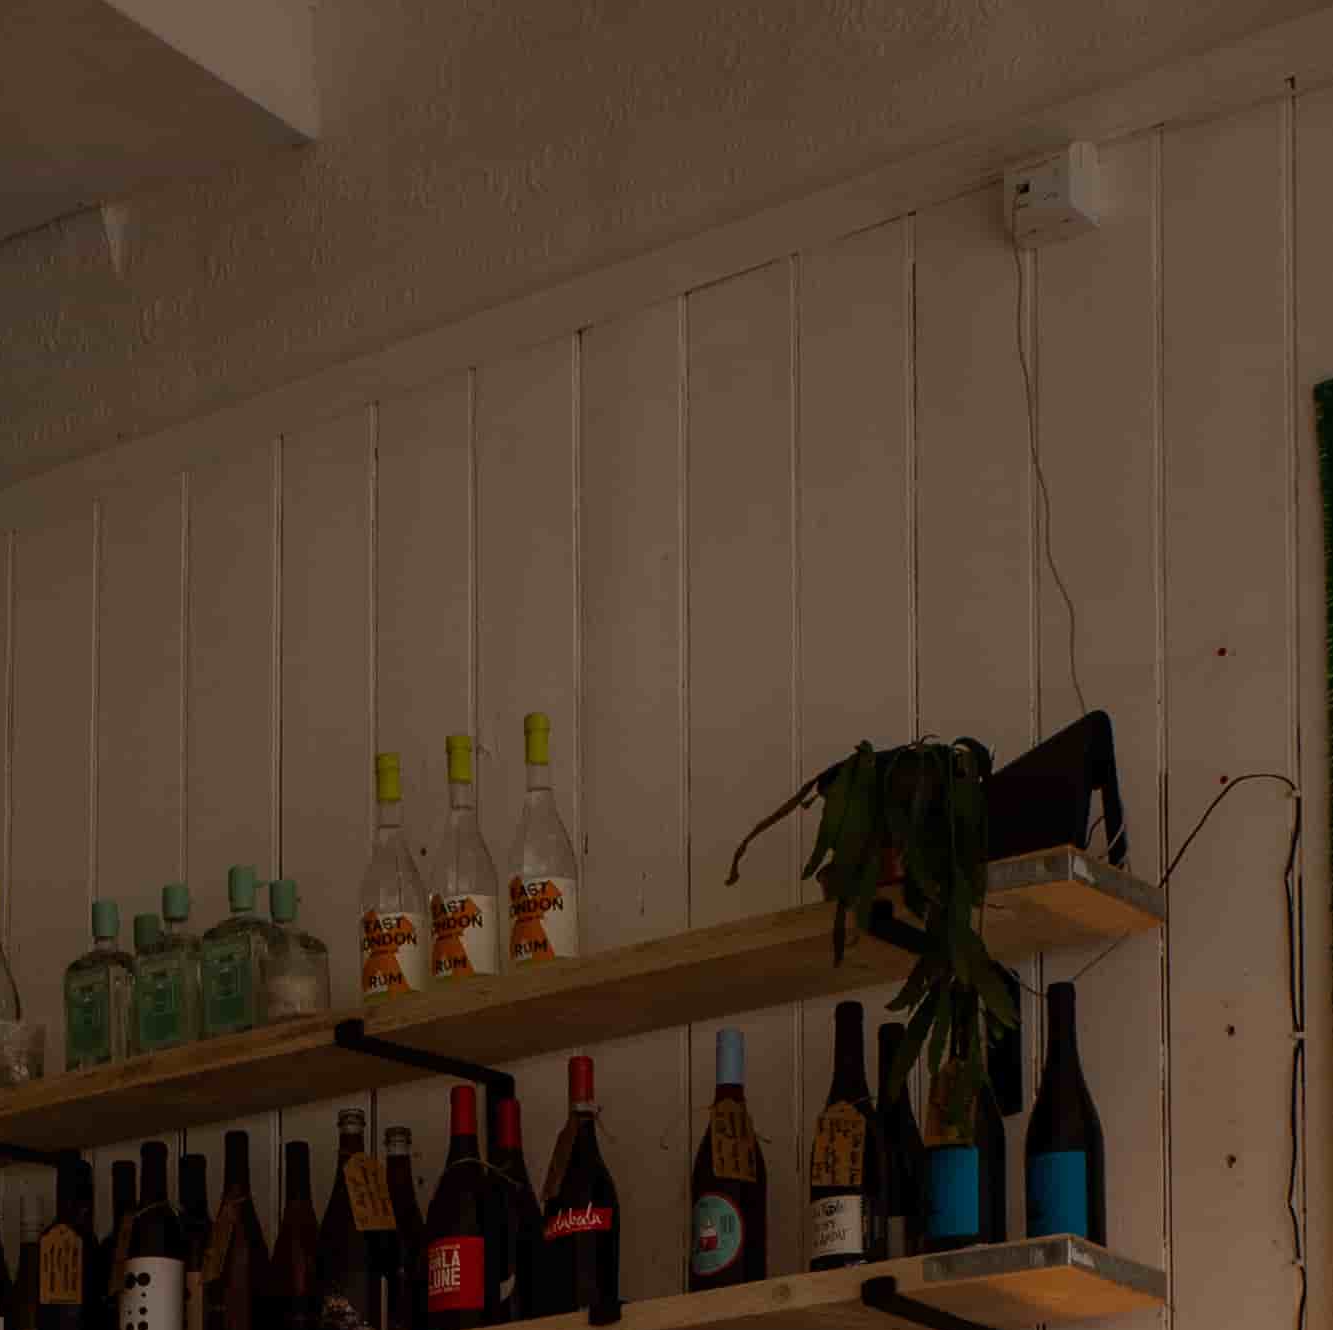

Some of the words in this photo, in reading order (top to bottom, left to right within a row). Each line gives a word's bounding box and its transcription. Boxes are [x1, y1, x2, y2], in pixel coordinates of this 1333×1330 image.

[511, 897, 564, 919] ONDON
[431, 915, 484, 937] ONDON
[363, 932, 418, 951] ONDON
[515, 939, 548, 958] RUM
[435, 956, 468, 975] RUM
[370, 972, 403, 989] RUM
